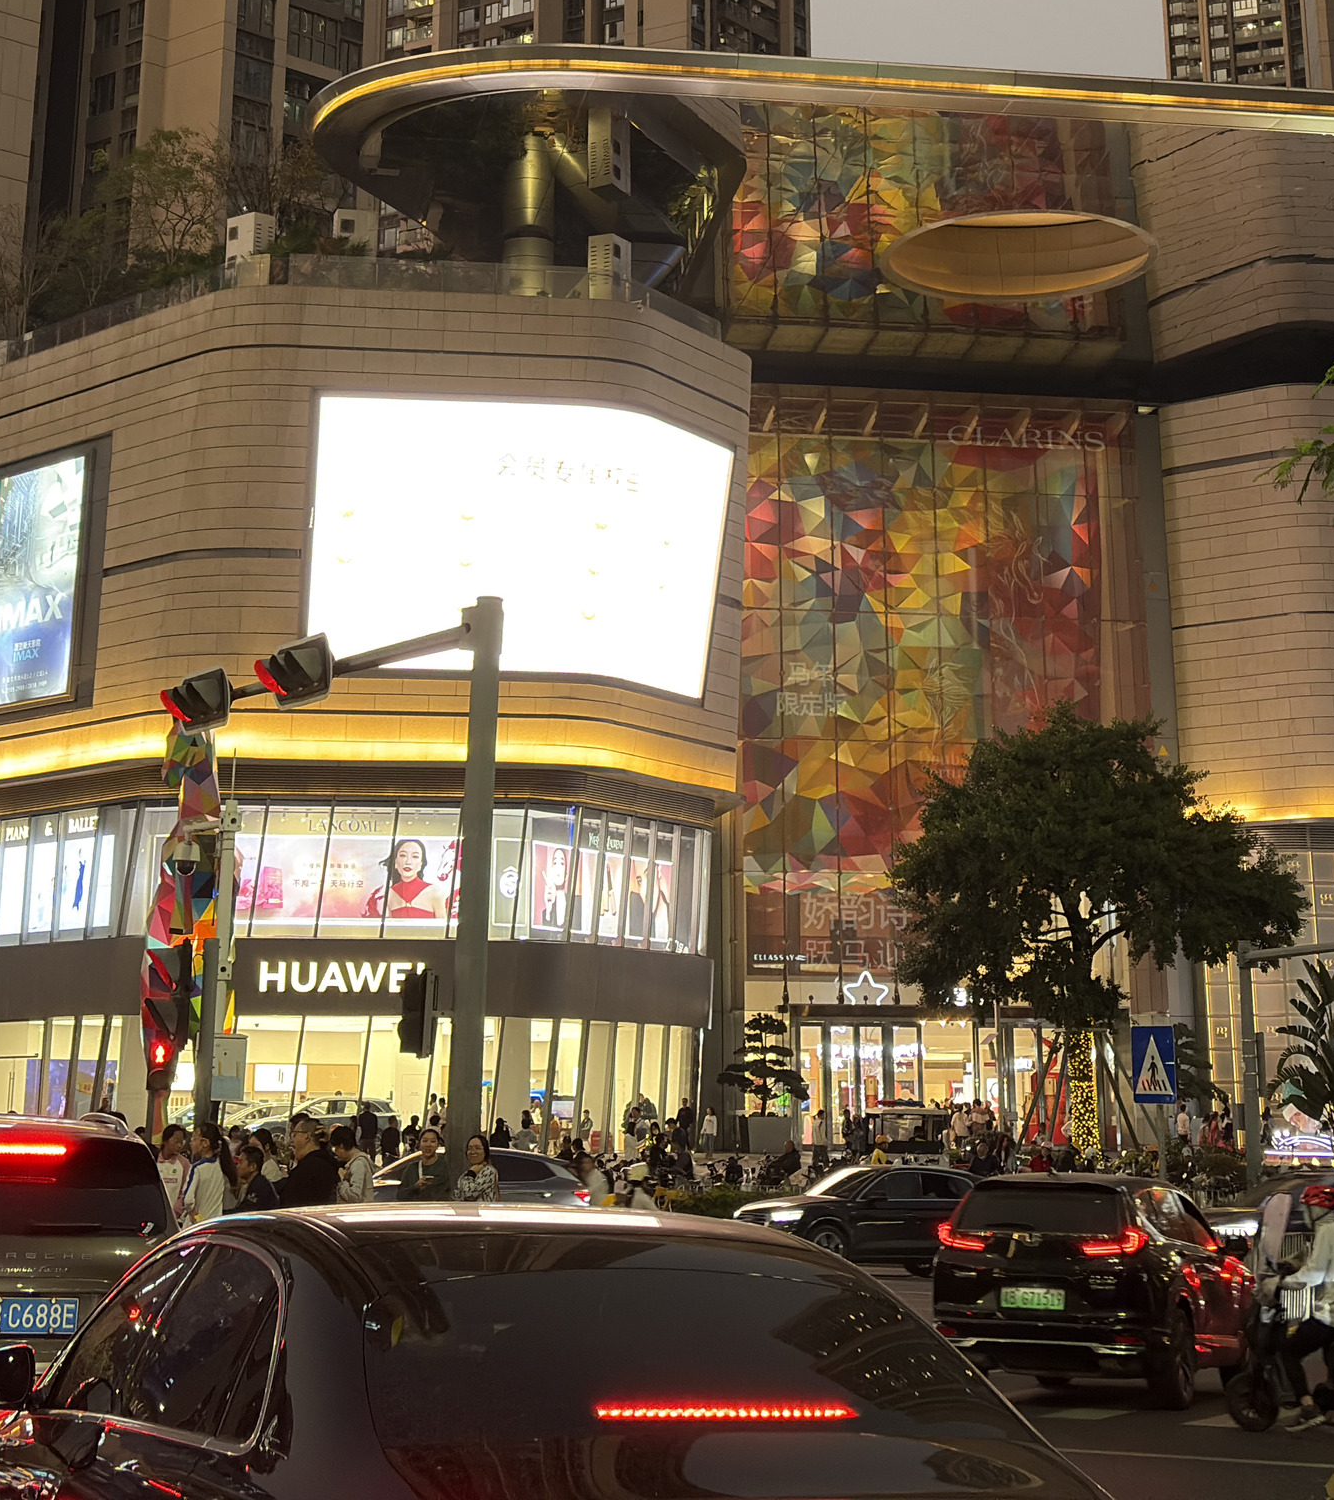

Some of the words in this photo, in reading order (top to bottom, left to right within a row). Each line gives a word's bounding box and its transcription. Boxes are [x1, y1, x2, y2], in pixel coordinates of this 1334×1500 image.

[947, 424, 1106, 451] CLARINS
[13, 648, 39, 663] IMAX
[292, 879, 364, 888] 不拘一天马行空
[804, 891, 913, 931] 娇韵诗
[805, 939, 906, 970] 跃马迎
